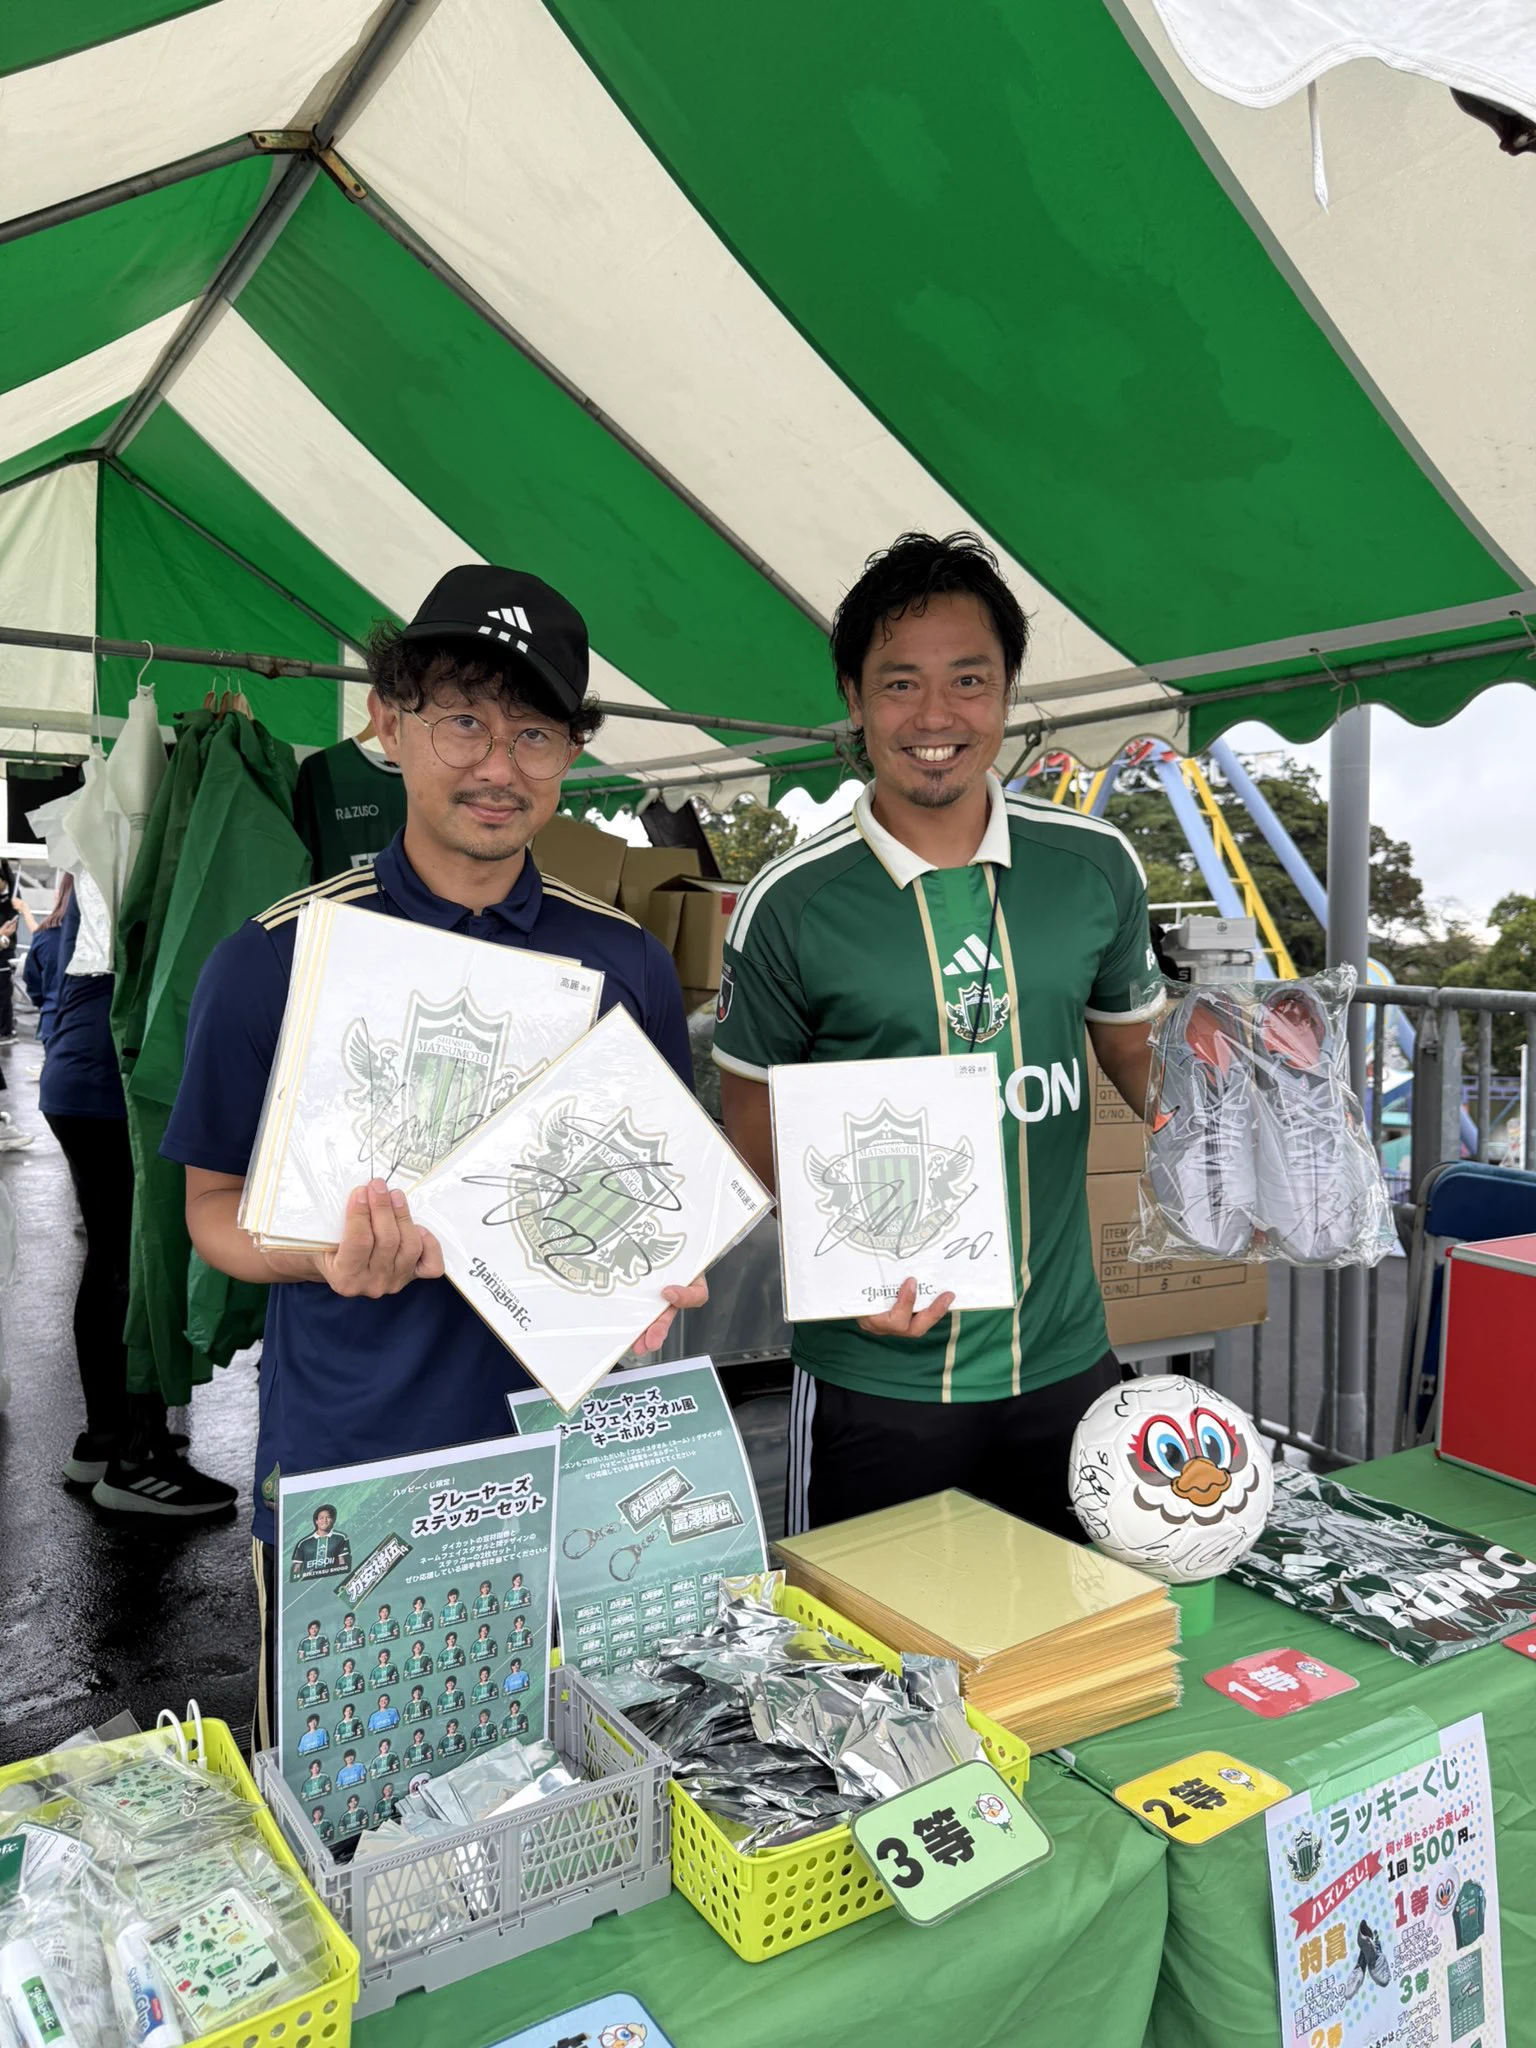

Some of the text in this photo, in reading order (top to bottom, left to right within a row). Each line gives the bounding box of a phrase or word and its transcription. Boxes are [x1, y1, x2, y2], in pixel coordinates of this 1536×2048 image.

[416, 1040, 490, 1064] MATSUMOTO
[996, 1057, 1081, 1123] ON
[858, 1144, 919, 1158] MATSUMOTO
[600, 1147, 647, 1203] MATSUMOTO
[1160, 1277, 1169, 1291] 5
[557, 1397, 697, 1436] ネームフェイスタオル風
[583, 1388, 661, 1415] プレーヤーズ
[593, 1420, 671, 1448] キーホルダー
[431, 1476, 532, 1511] プレーヤーズ
[413, 1494, 544, 1535] ステッカーセット
[1228, 1665, 1300, 1702] 1等
[1141, 1777, 1228, 1829] 2等
[1329, 1757, 1460, 1847] ラッキーくじ
[877, 1806, 976, 1889] 3等
[1385, 1800, 1475, 1858] 何が当たるかお楽しみ！
[1311, 1860, 1369, 1924] ハズレなし！
[1394, 1885, 1430, 1928] 1等
[1299, 1922, 1348, 1982] 特賞
[1399, 1968, 1430, 2004] 3等
